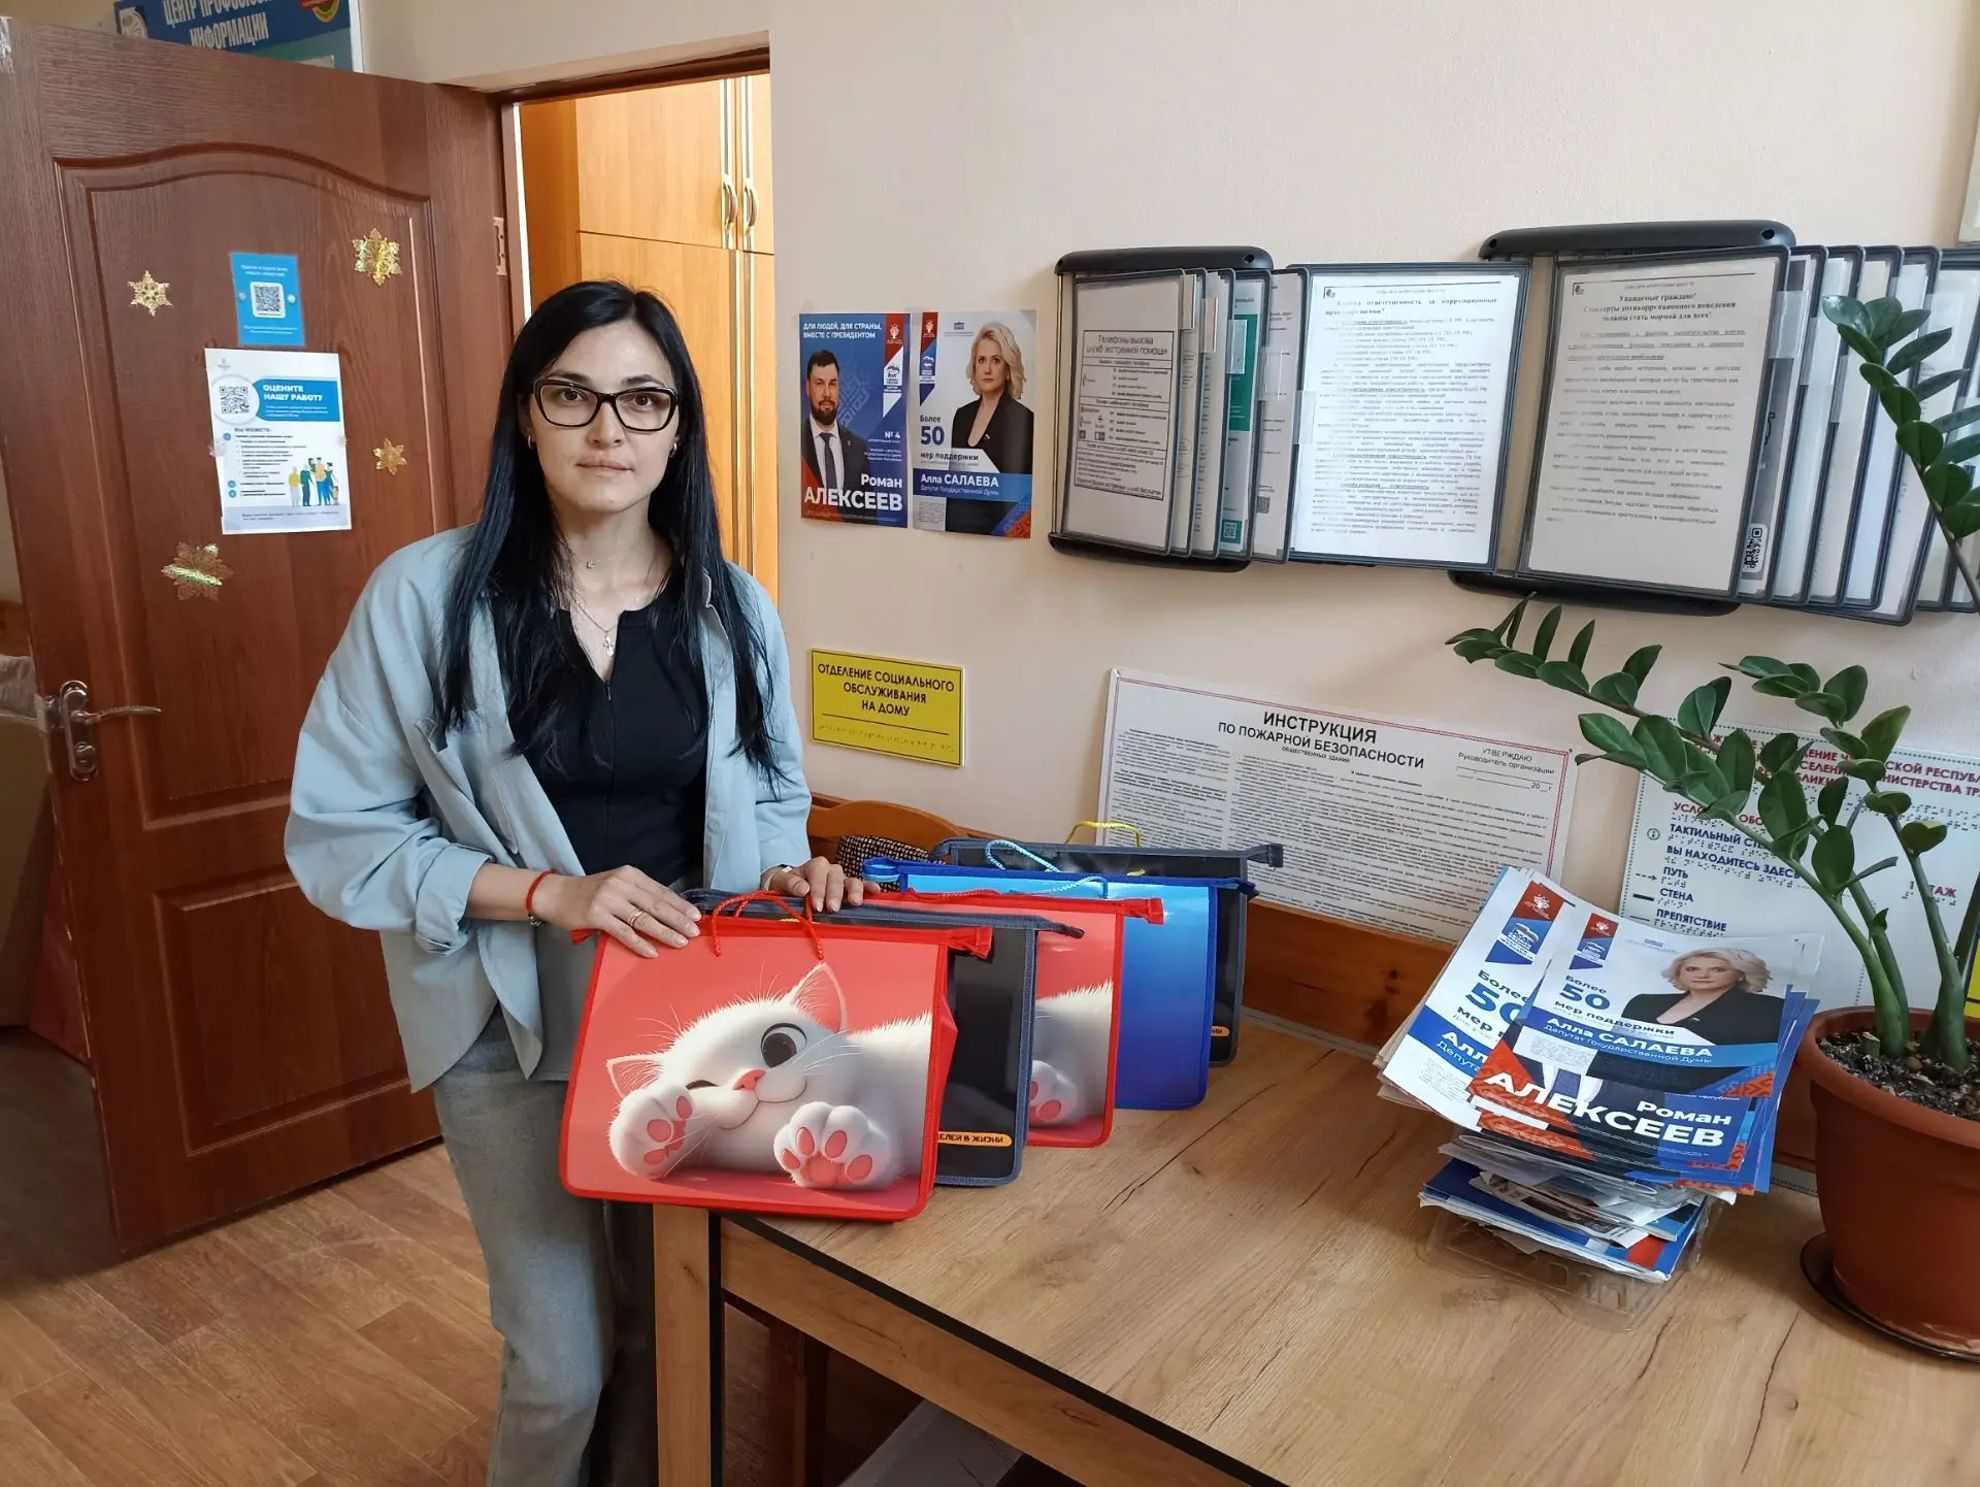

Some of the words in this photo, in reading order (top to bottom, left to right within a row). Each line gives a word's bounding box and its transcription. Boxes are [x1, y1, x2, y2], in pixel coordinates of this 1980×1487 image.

[189, 12, 269, 49] ИНФОРМАЦИИ
[263, 384, 304, 393] ОЦЕНИТЕ
[920, 414, 941, 423] Более
[895, 431, 901, 439] 4
[920, 426, 945, 446] 50
[935, 453, 979, 462] поддержки
[861, 473, 902, 488] Роман
[921, 474, 943, 484] Алла
[944, 474, 999, 488] САЛАЕВА
[804, 487, 903, 511] АЛЕКСЕЕВ
[818, 663, 872, 680] ОТДЕЛЕНИЕ
[875, 671, 955, 692] СОЦИАЛЬНОГО
[843, 682, 926, 704] ОБСЛУЖИВАНИЯ
[862, 700, 876, 713] НА
[878, 703, 911, 717] ДОМУ
[1263, 711, 1377, 743] ИНСТРУКЦИЯ
[1218, 722, 1236, 735] ПО
[1239, 726, 1311, 748] ПОЖАРНОЙ
[1314, 738, 1425, 769] БЕЗОПАСНОСТИ
[1482, 747, 1533, 762] УТВЕРЖДАЮ
[1458, 752, 1507, 767] Руководитель
[1508, 762, 1555, 775] организации
[1882, 774, 1962, 795] НИСТЕРСТВА
[1670, 823, 1742, 845] ТАКТИЛЬНЫЙ
[1663, 866, 1689, 879] ПУТЬ
[1666, 845, 1683, 856] ВЫ
[1685, 848, 1761, 871] НАХОДИТЕСЬ
[1763, 864, 1801, 880] ЗДЕСЬ
[1660, 887, 1694, 902] СТЕНА
[1928, 884, 1957, 898] ТАЖ
[1656, 908, 1728, 932] ПРЕПЯТСТВИЕ
[1565, 974, 1607, 994] Более
[1559, 983, 1611, 1010] 50
[1544, 1024, 1586, 1042] Депутат
[1586, 1012, 1675, 1035] поддержки
[1442, 1031, 1489, 1063] Алл
[1547, 1018, 1594, 1039] Алла
[1598, 1033, 1713, 1057] САЛАЕВА
[1483, 1071, 1724, 1147] АЛЕКСЕЕВ
[1636, 1100, 1732, 1125] Роман
[963, 1134, 970, 1142] В
[972, 1135, 1004, 1144] ЖИЗНИ
